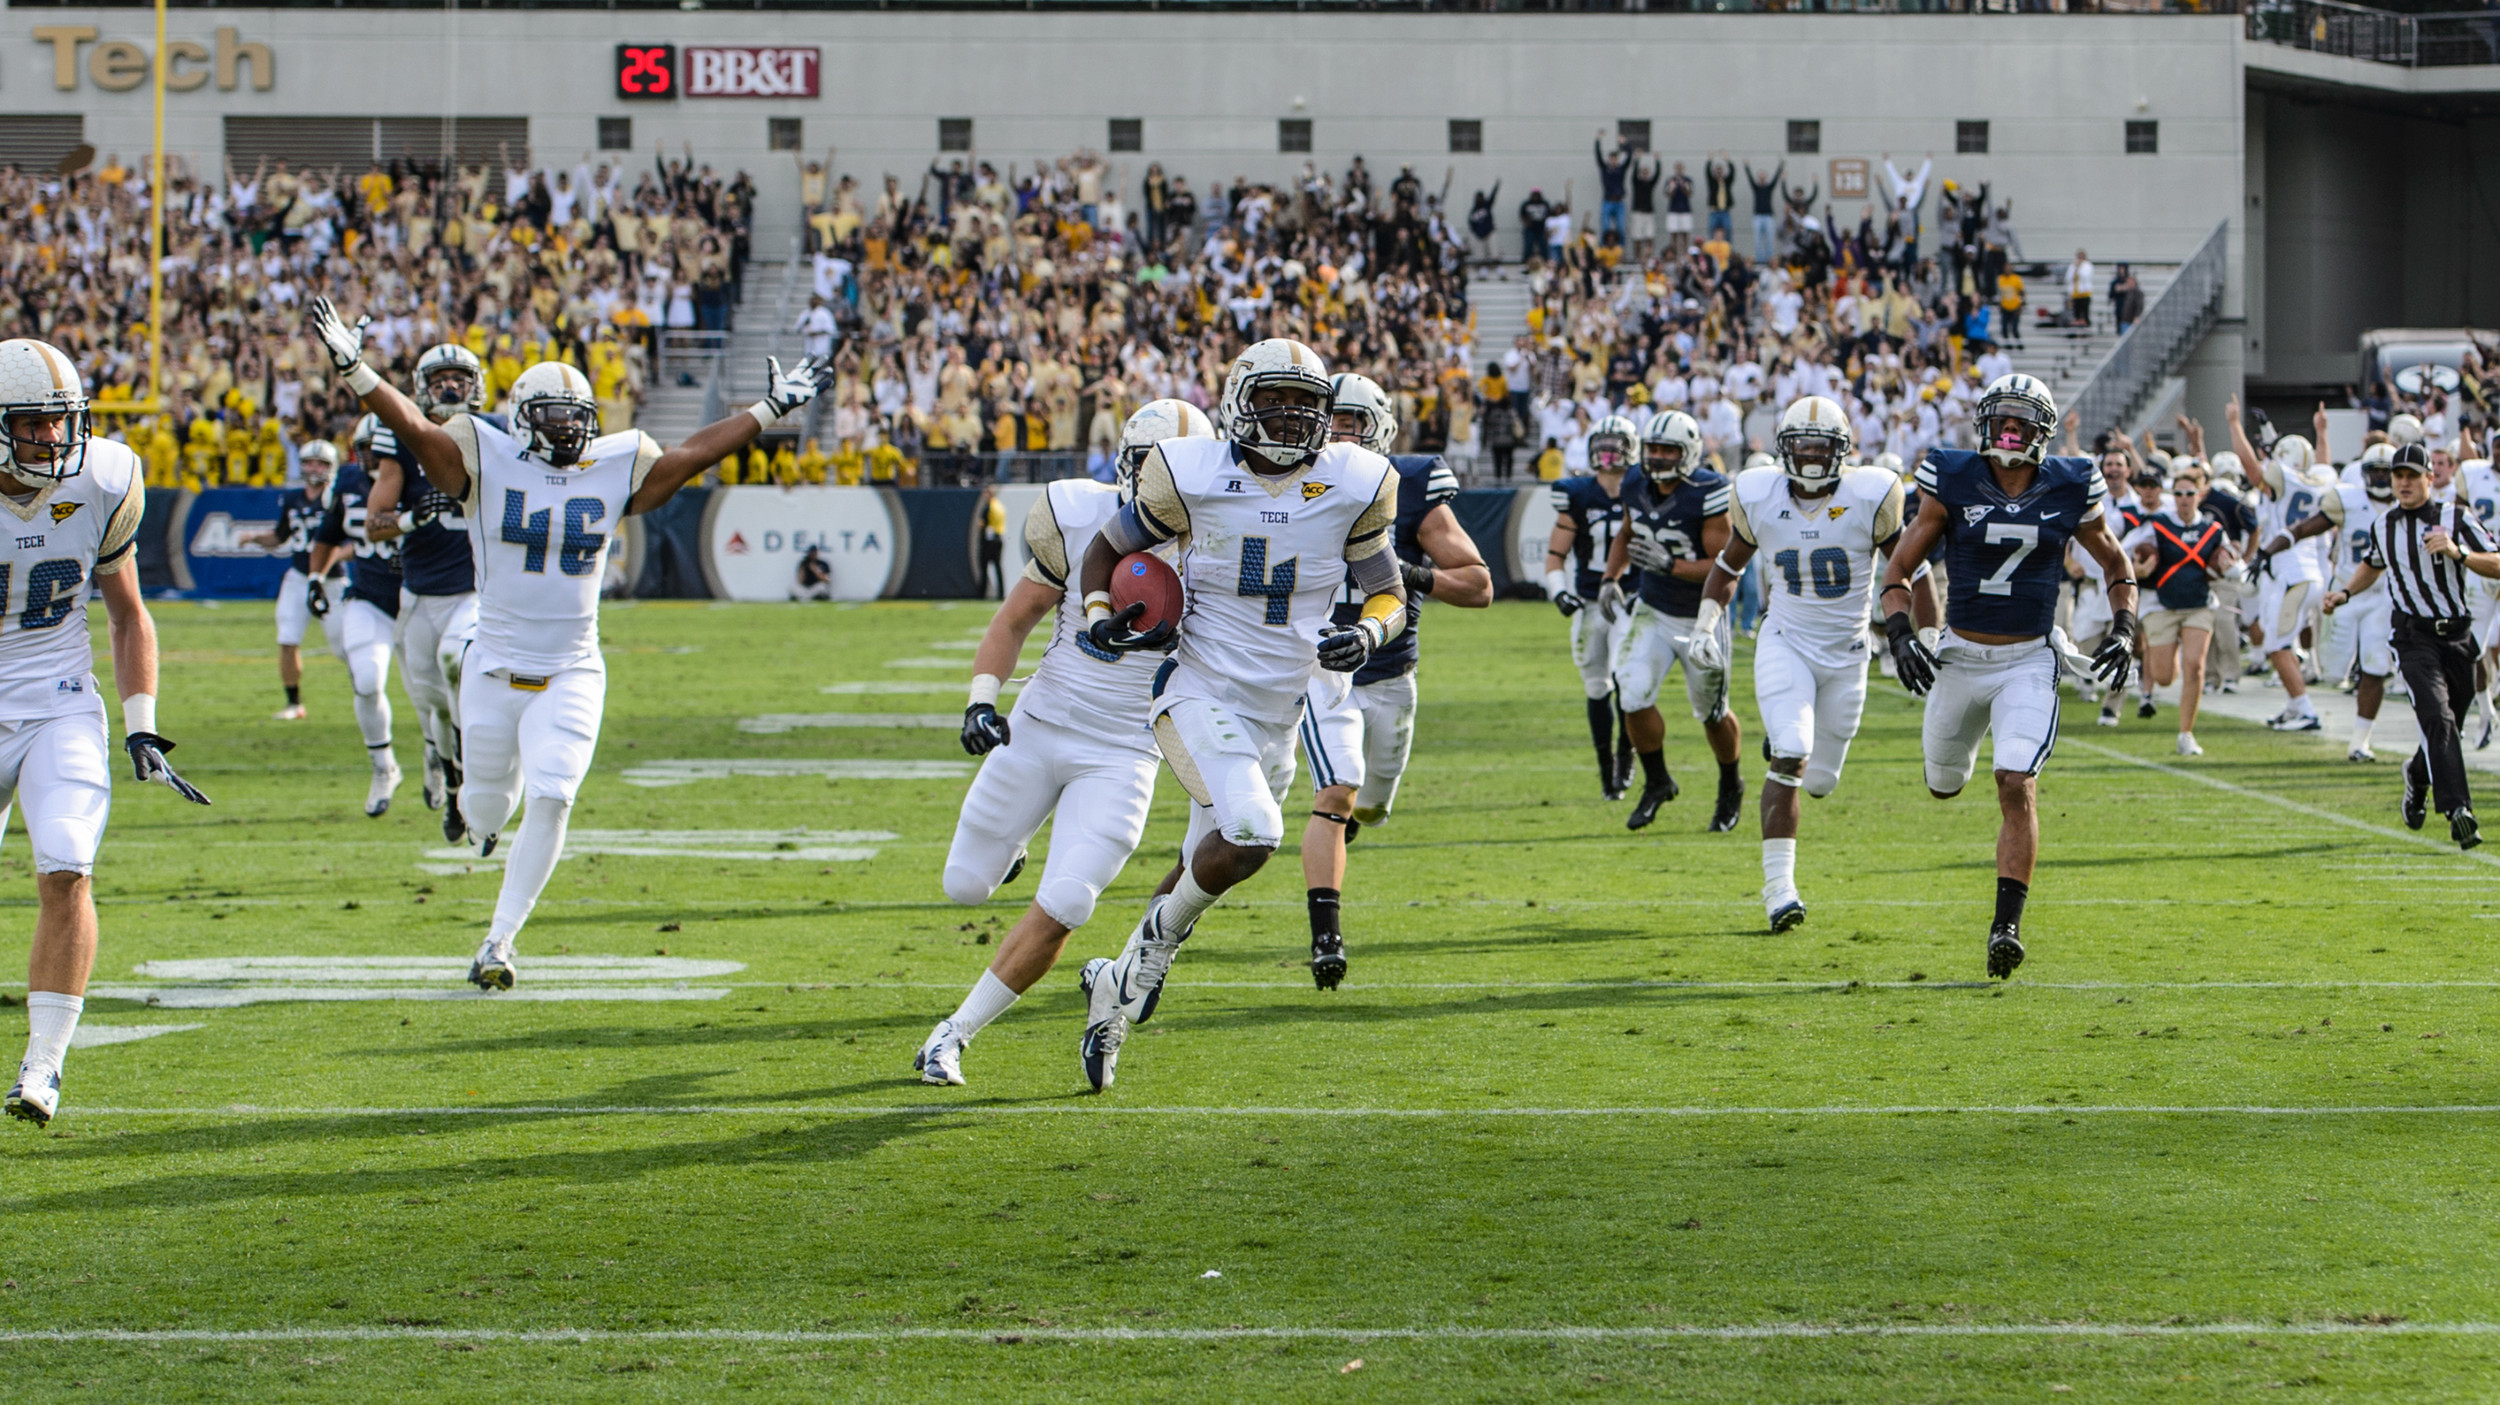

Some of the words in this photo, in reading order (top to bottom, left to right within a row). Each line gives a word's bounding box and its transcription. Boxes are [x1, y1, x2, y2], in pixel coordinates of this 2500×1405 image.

[33, 26, 274, 93] Tech
[621, 47, 670, 93] 25
[687, 49, 818, 95] BB&T
[545, 475, 567, 485] TECH
[53, 502, 74, 515] ACC
[1260, 511, 1289, 524] TECH
[15, 535, 45, 549] TECH
[501, 487, 606, 578] 46
[764, 531, 882, 553] DELTA
[1800, 530, 1820, 540] TECH
[1237, 535, 1299, 628] 4
[1774, 546, 1851, 600] 10
[1978, 522, 2039, 596] 7
